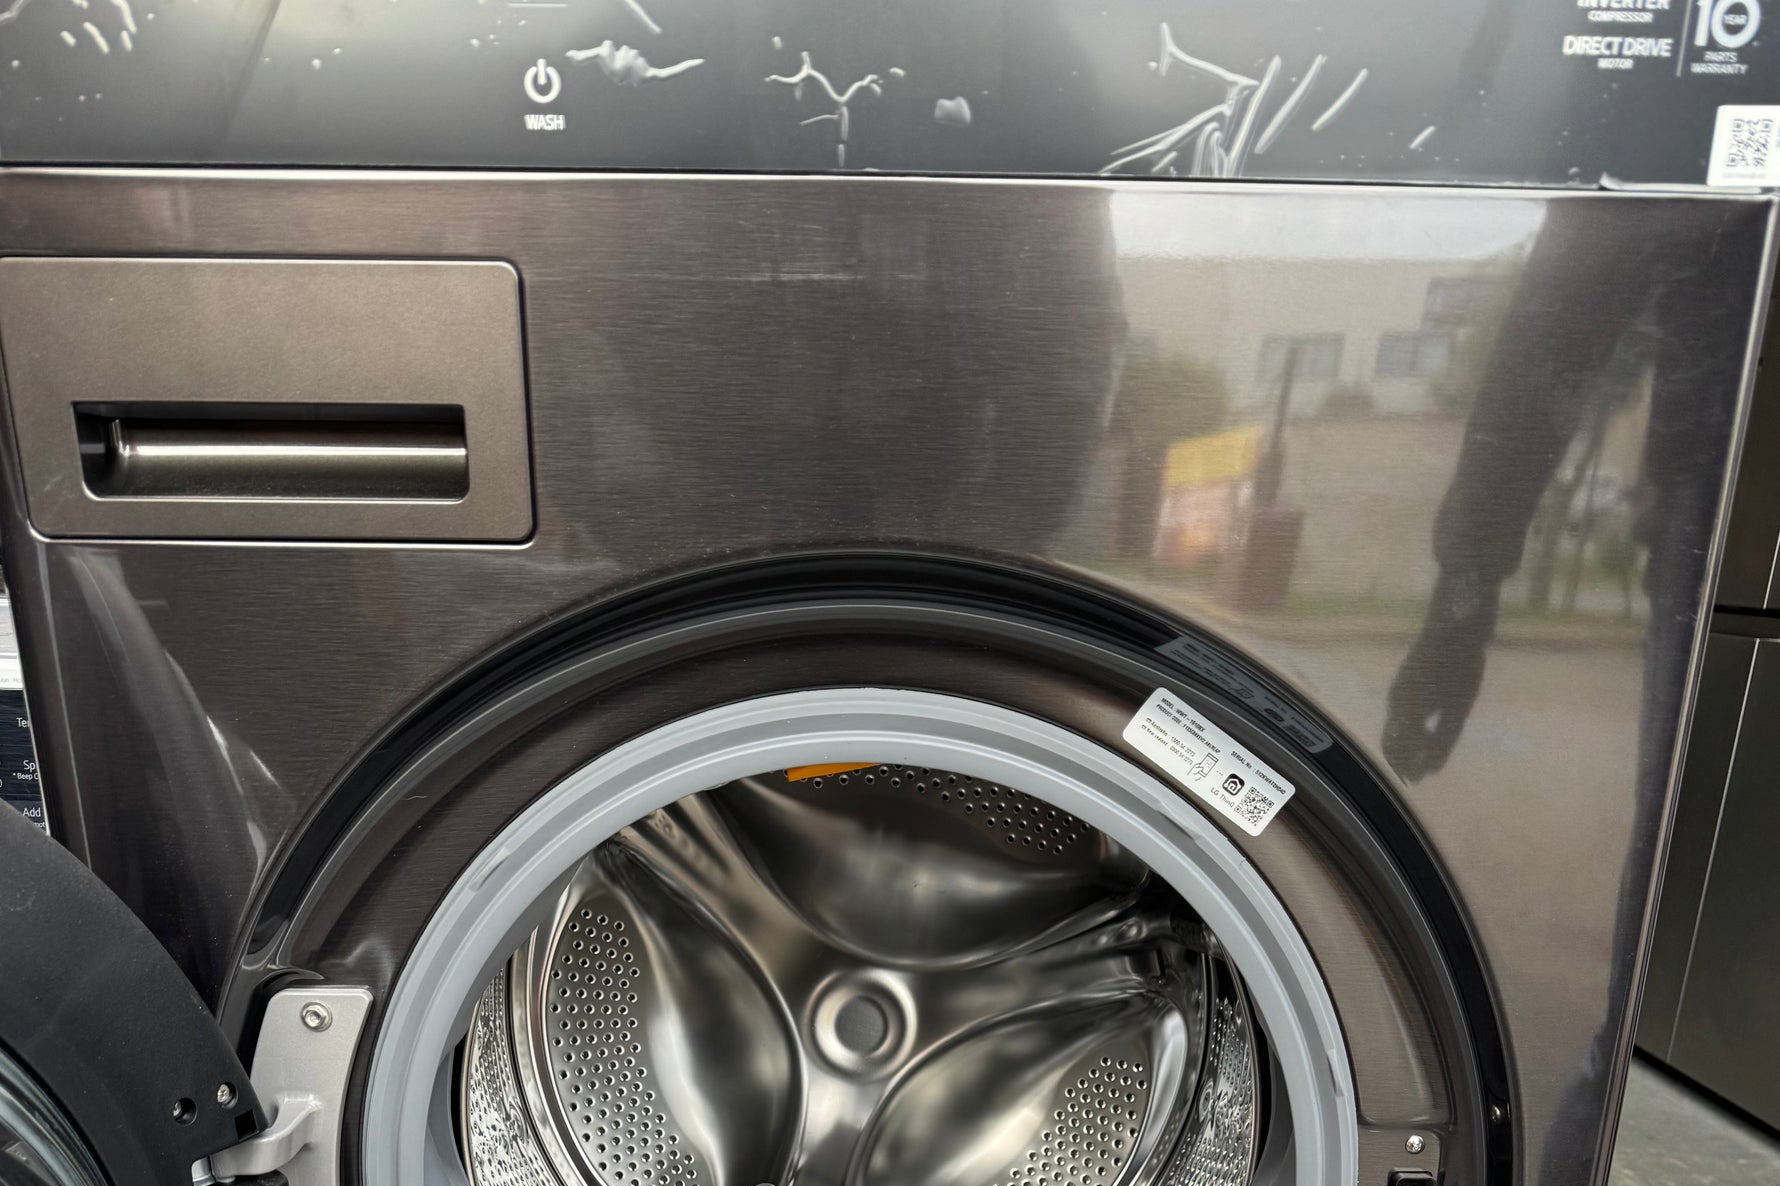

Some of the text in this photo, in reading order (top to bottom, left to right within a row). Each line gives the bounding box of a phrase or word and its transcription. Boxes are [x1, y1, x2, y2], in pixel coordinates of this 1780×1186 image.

[1694, 0, 1760, 48] 10
[1562, 35, 1674, 57] DIRECT DRIVE
[1597, 58, 1634, 69] MOTOR
[524, 114, 566, 130] WASH
[23, 760, 36, 772] Sp
[17, 772, 33, 781] Beep
[1210, 787, 1220, 796] LG
[23, 807, 41, 817] Add
